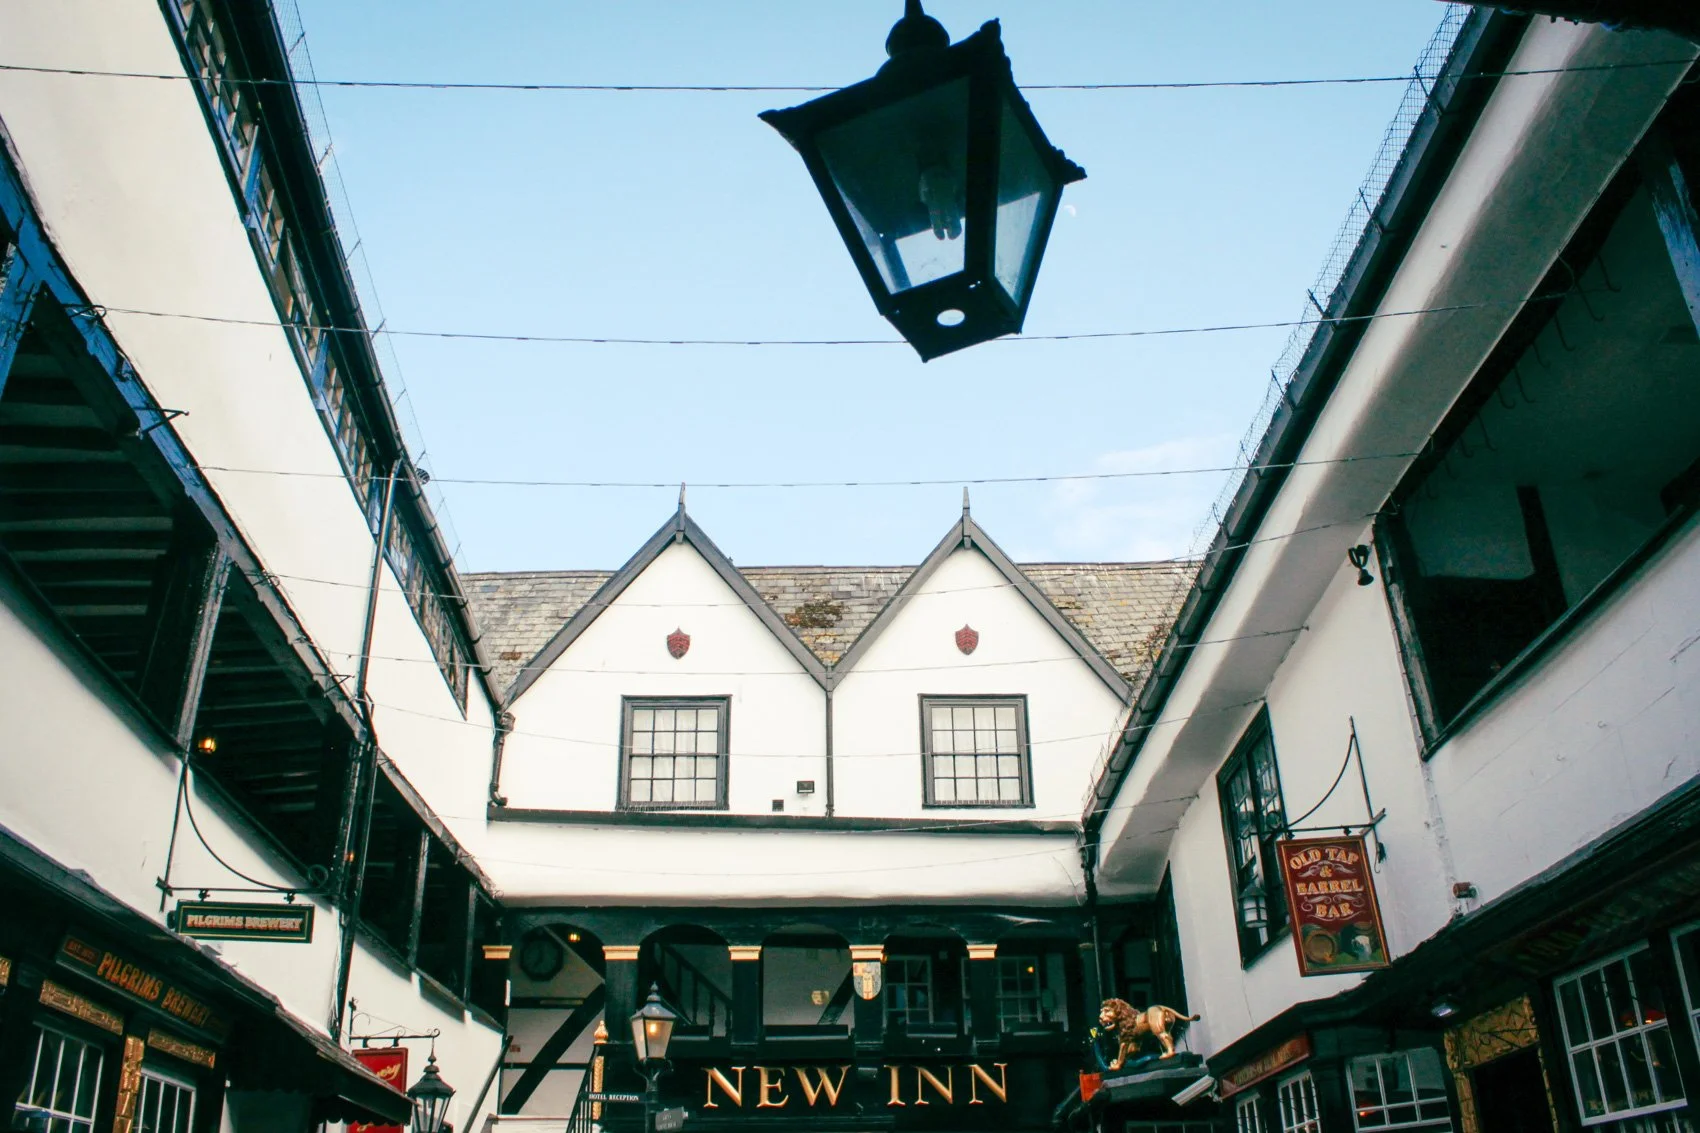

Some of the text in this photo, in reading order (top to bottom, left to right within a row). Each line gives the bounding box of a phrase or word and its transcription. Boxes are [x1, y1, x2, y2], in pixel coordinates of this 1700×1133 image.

[1290, 848, 1359, 869] OLD TAP
[1319, 865, 1333, 878] &
[1296, 879, 1364, 895] BARREL
[1315, 903, 1354, 918] BAR
[186, 914, 303, 931] PILGRIMS BREWERY
[97, 952, 163, 1001] PILGRIMS
[161, 987, 210, 1028] BREWERY
[702, 1063, 1008, 1108] NEW INN
[588, 1093, 607, 1101] HOTEL
